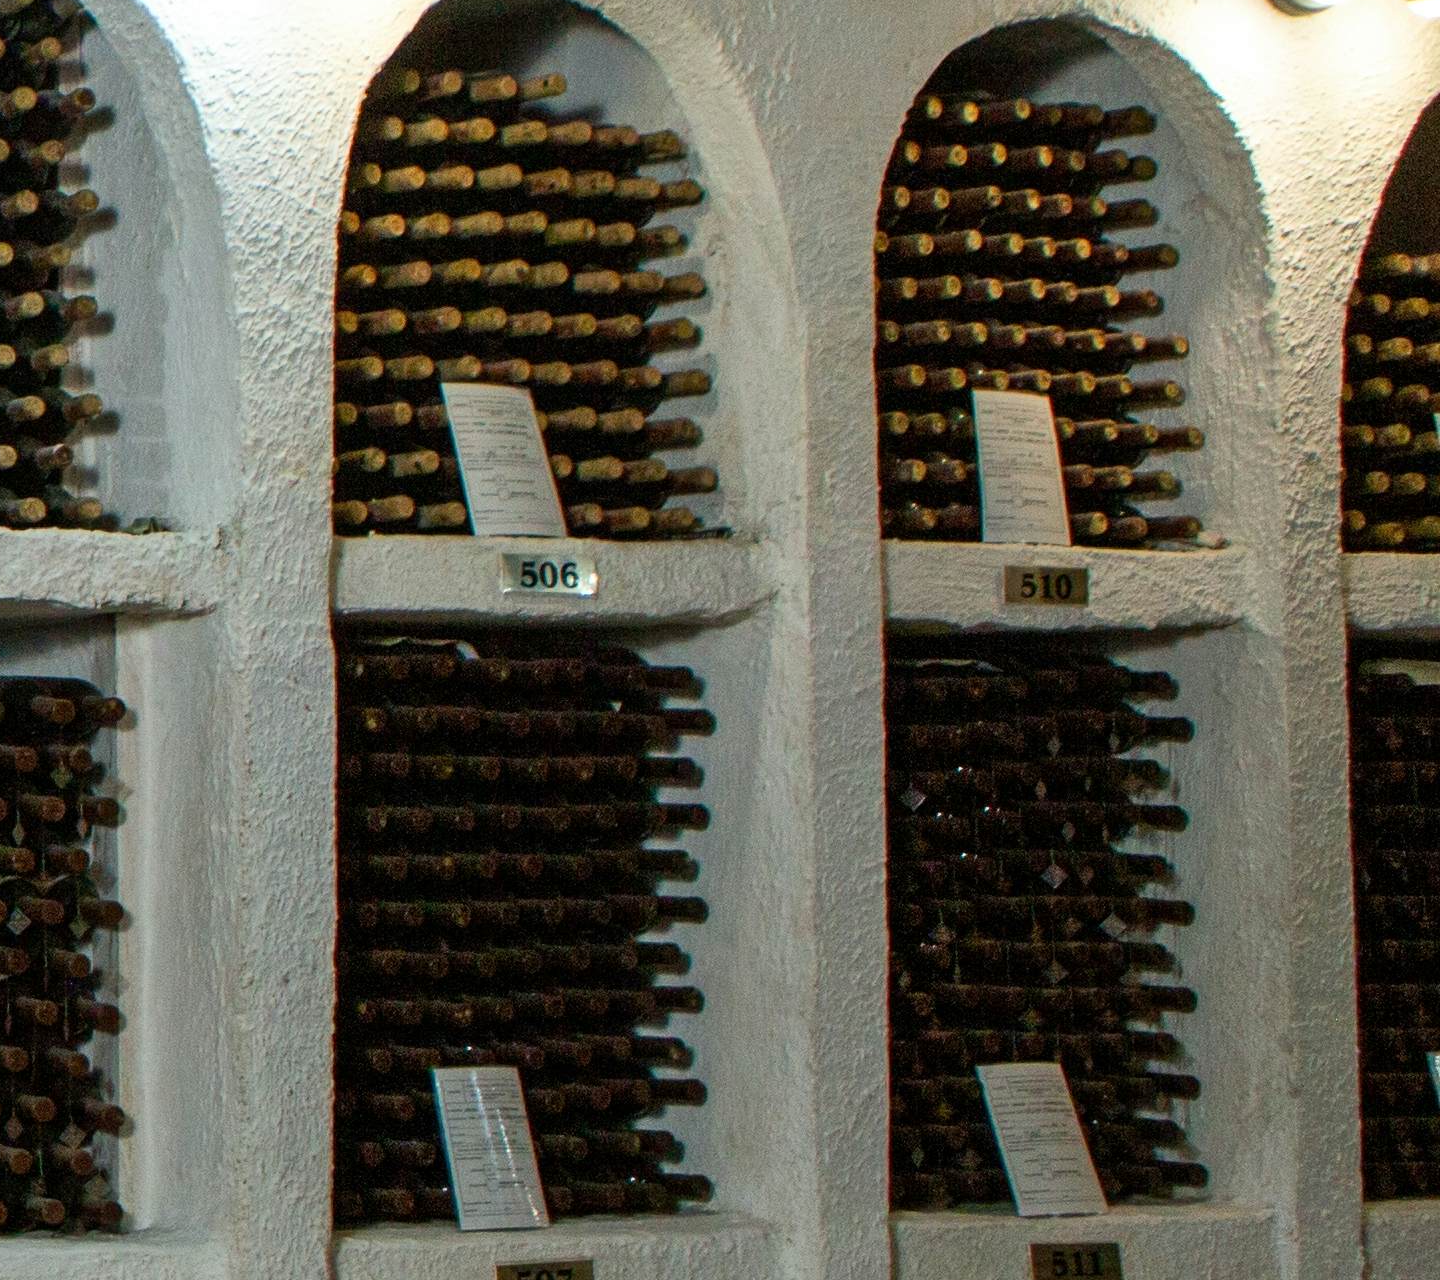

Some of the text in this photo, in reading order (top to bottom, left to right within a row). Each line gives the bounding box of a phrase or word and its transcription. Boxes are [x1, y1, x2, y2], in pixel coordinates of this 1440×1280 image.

[520, 560, 580, 589] 506
[1021, 573, 1073, 600] 510
[1052, 1251, 1105, 1279] 511
